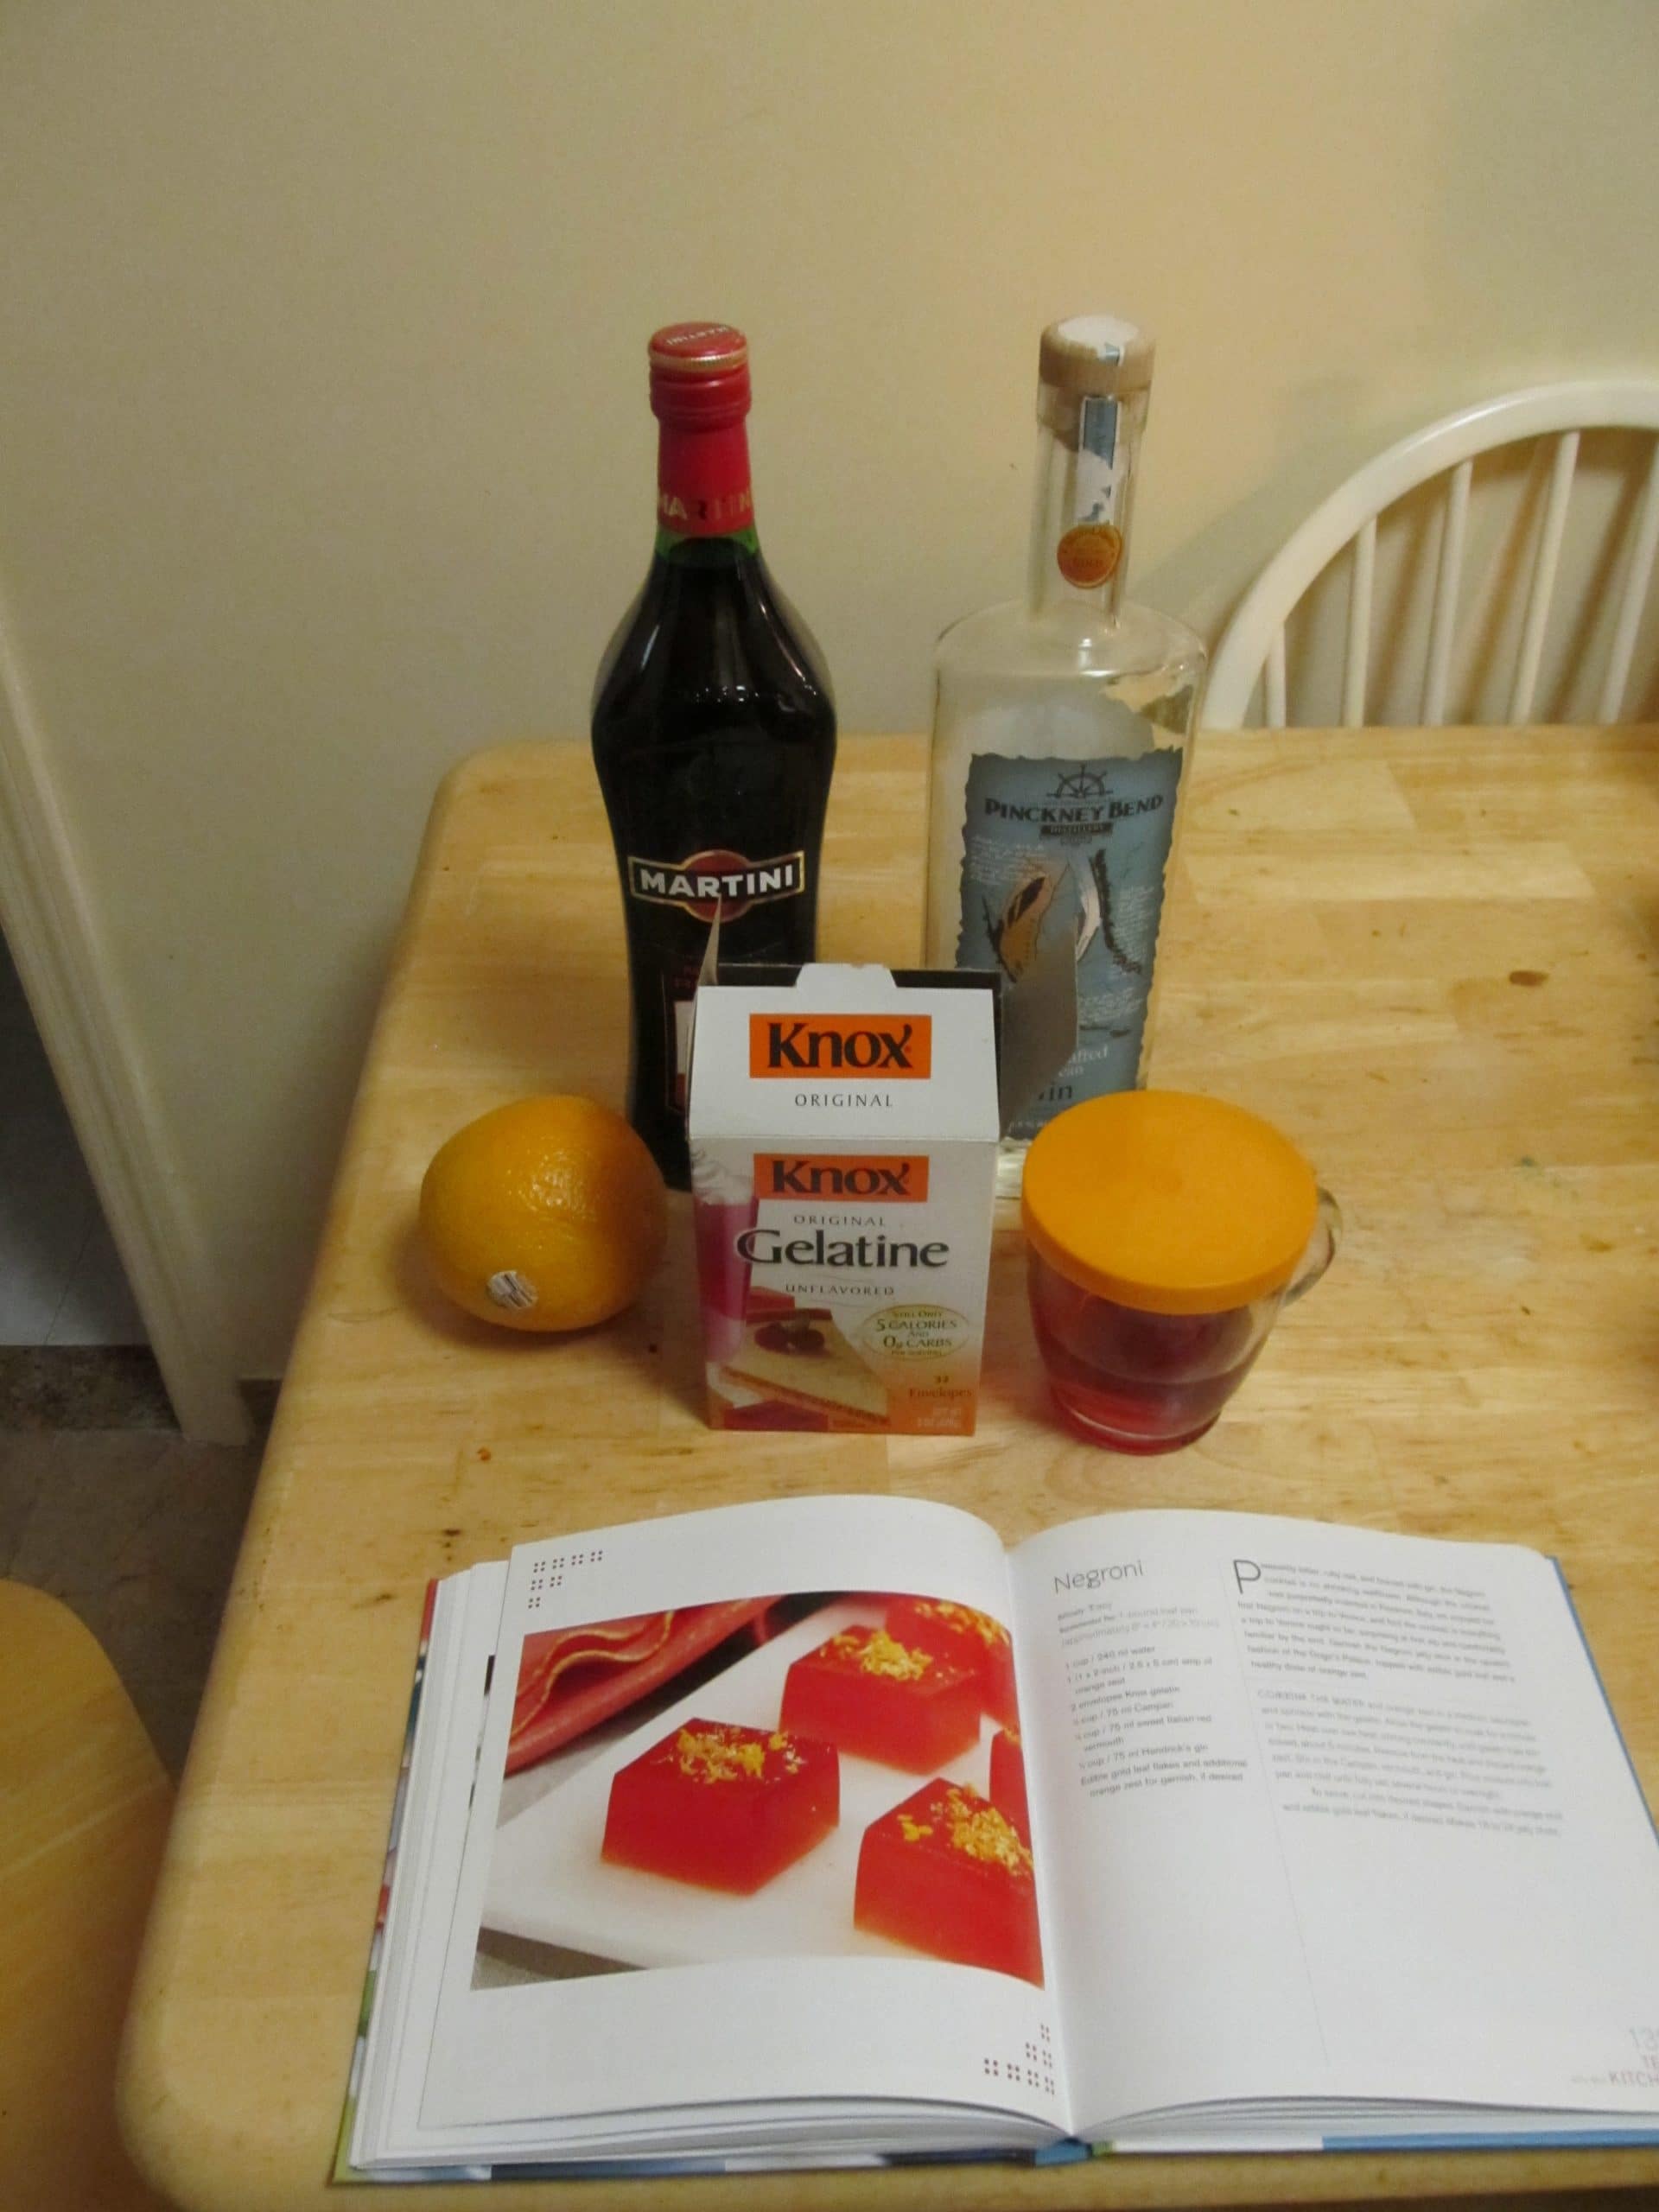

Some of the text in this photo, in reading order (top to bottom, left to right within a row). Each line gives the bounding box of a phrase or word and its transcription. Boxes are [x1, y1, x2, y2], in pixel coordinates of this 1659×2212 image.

[984, 794, 1164, 823] PINCKNEY BEND
[640, 863, 793, 899] MARTINI
[767, 1023, 913, 1068] Knox
[794, 1093, 893, 1107] ORIGINAL
[772, 1160, 911, 1196] Knox
[793, 1214, 887, 1227] ORIGINAL
[737, 1230, 950, 1268] Gelatine
[785, 1284, 895, 1296] UNFLAVORED
[1053, 1558, 1144, 1595] Negroni
